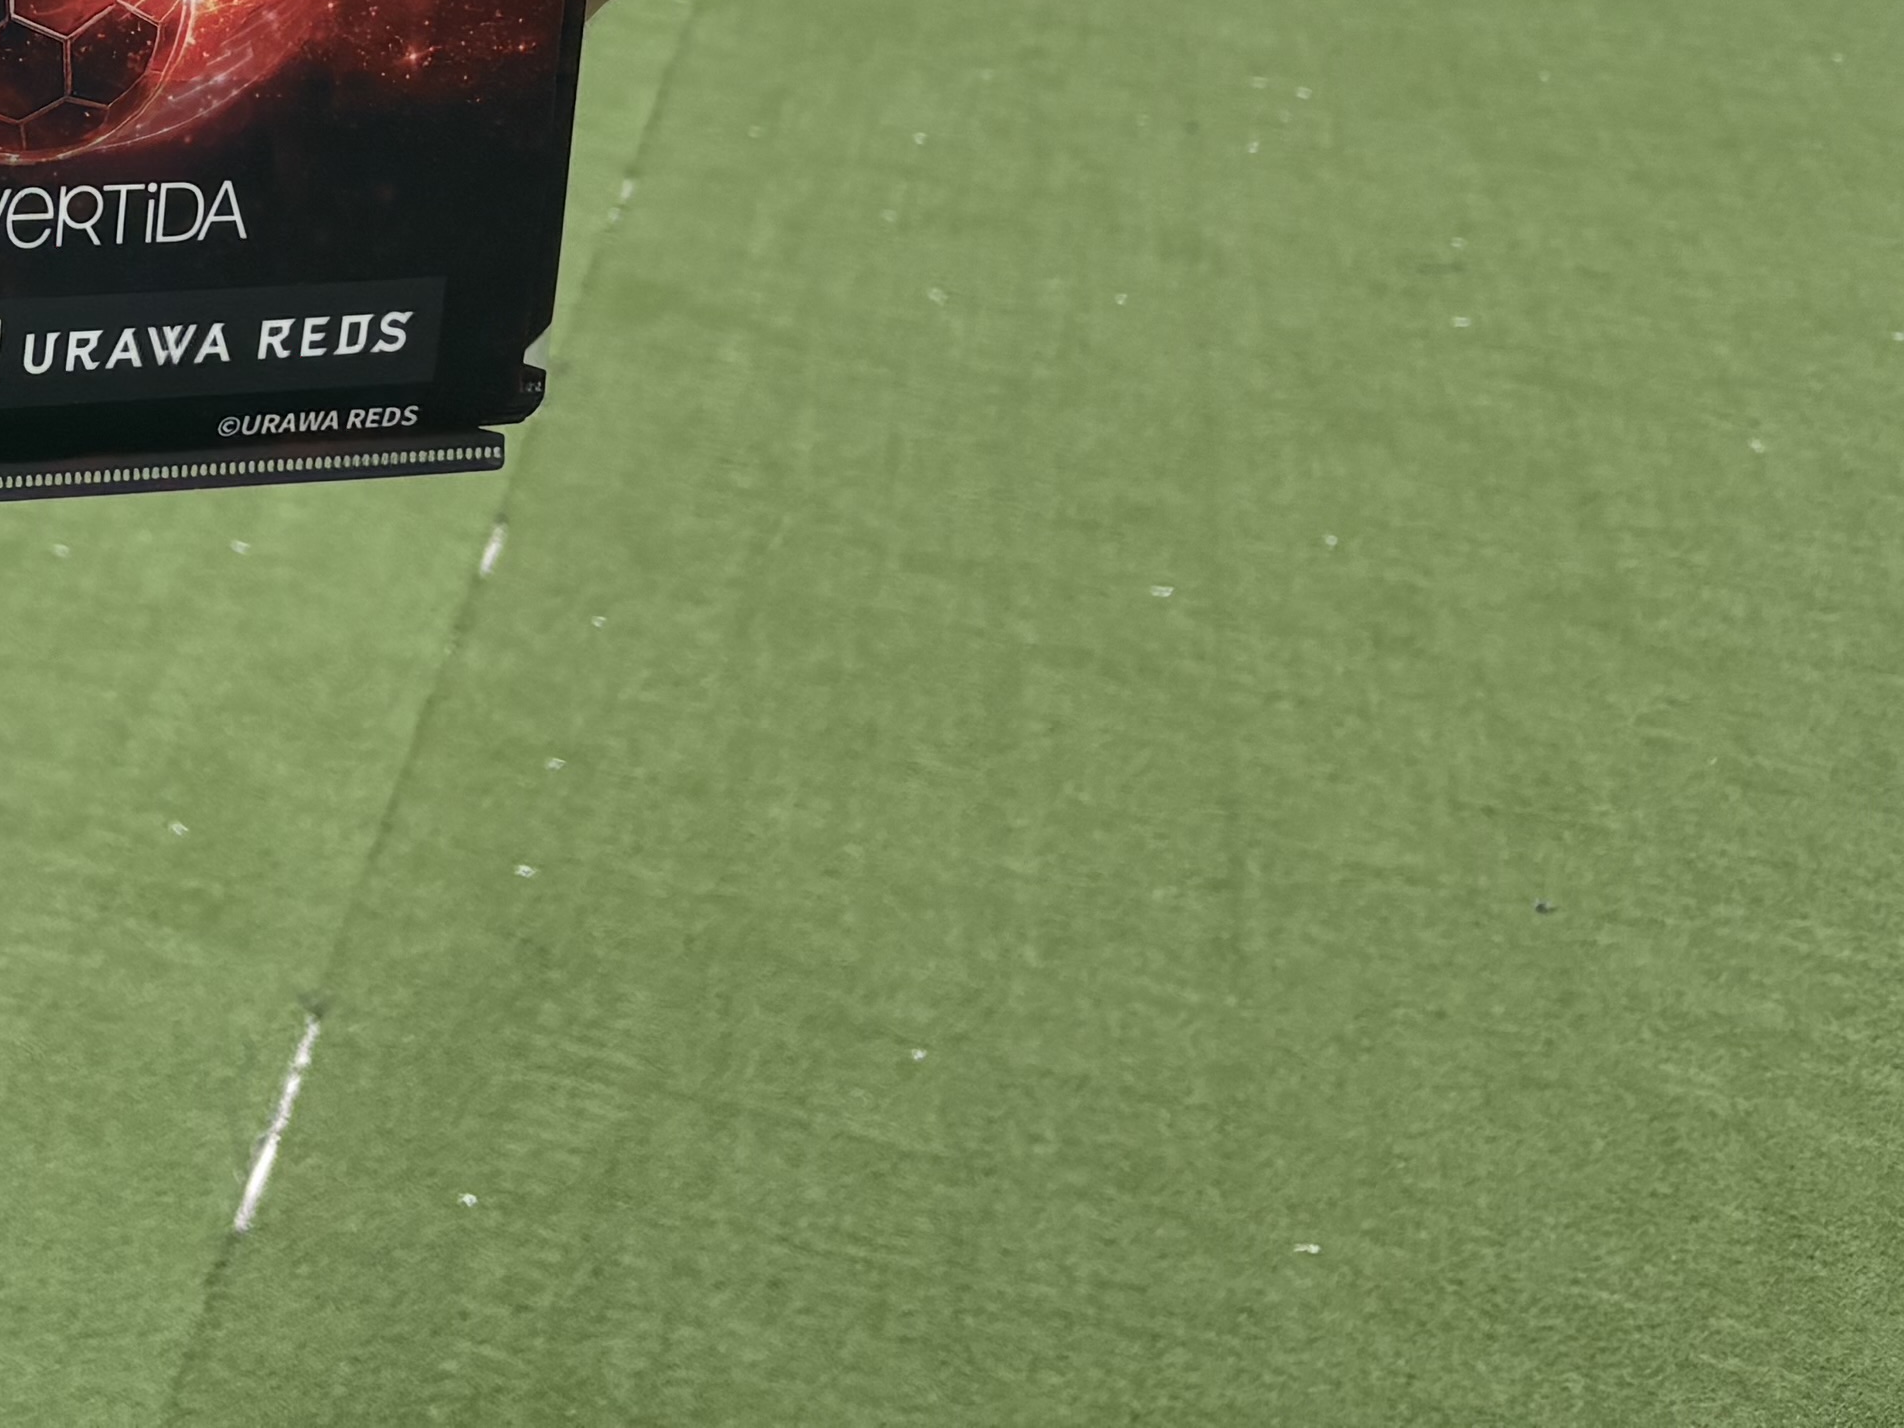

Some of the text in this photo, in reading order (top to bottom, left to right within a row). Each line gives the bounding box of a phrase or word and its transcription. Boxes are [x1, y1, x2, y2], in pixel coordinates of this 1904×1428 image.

[22, 311, 414, 375] URAWA REDS
[345, 404, 420, 431] REDS
